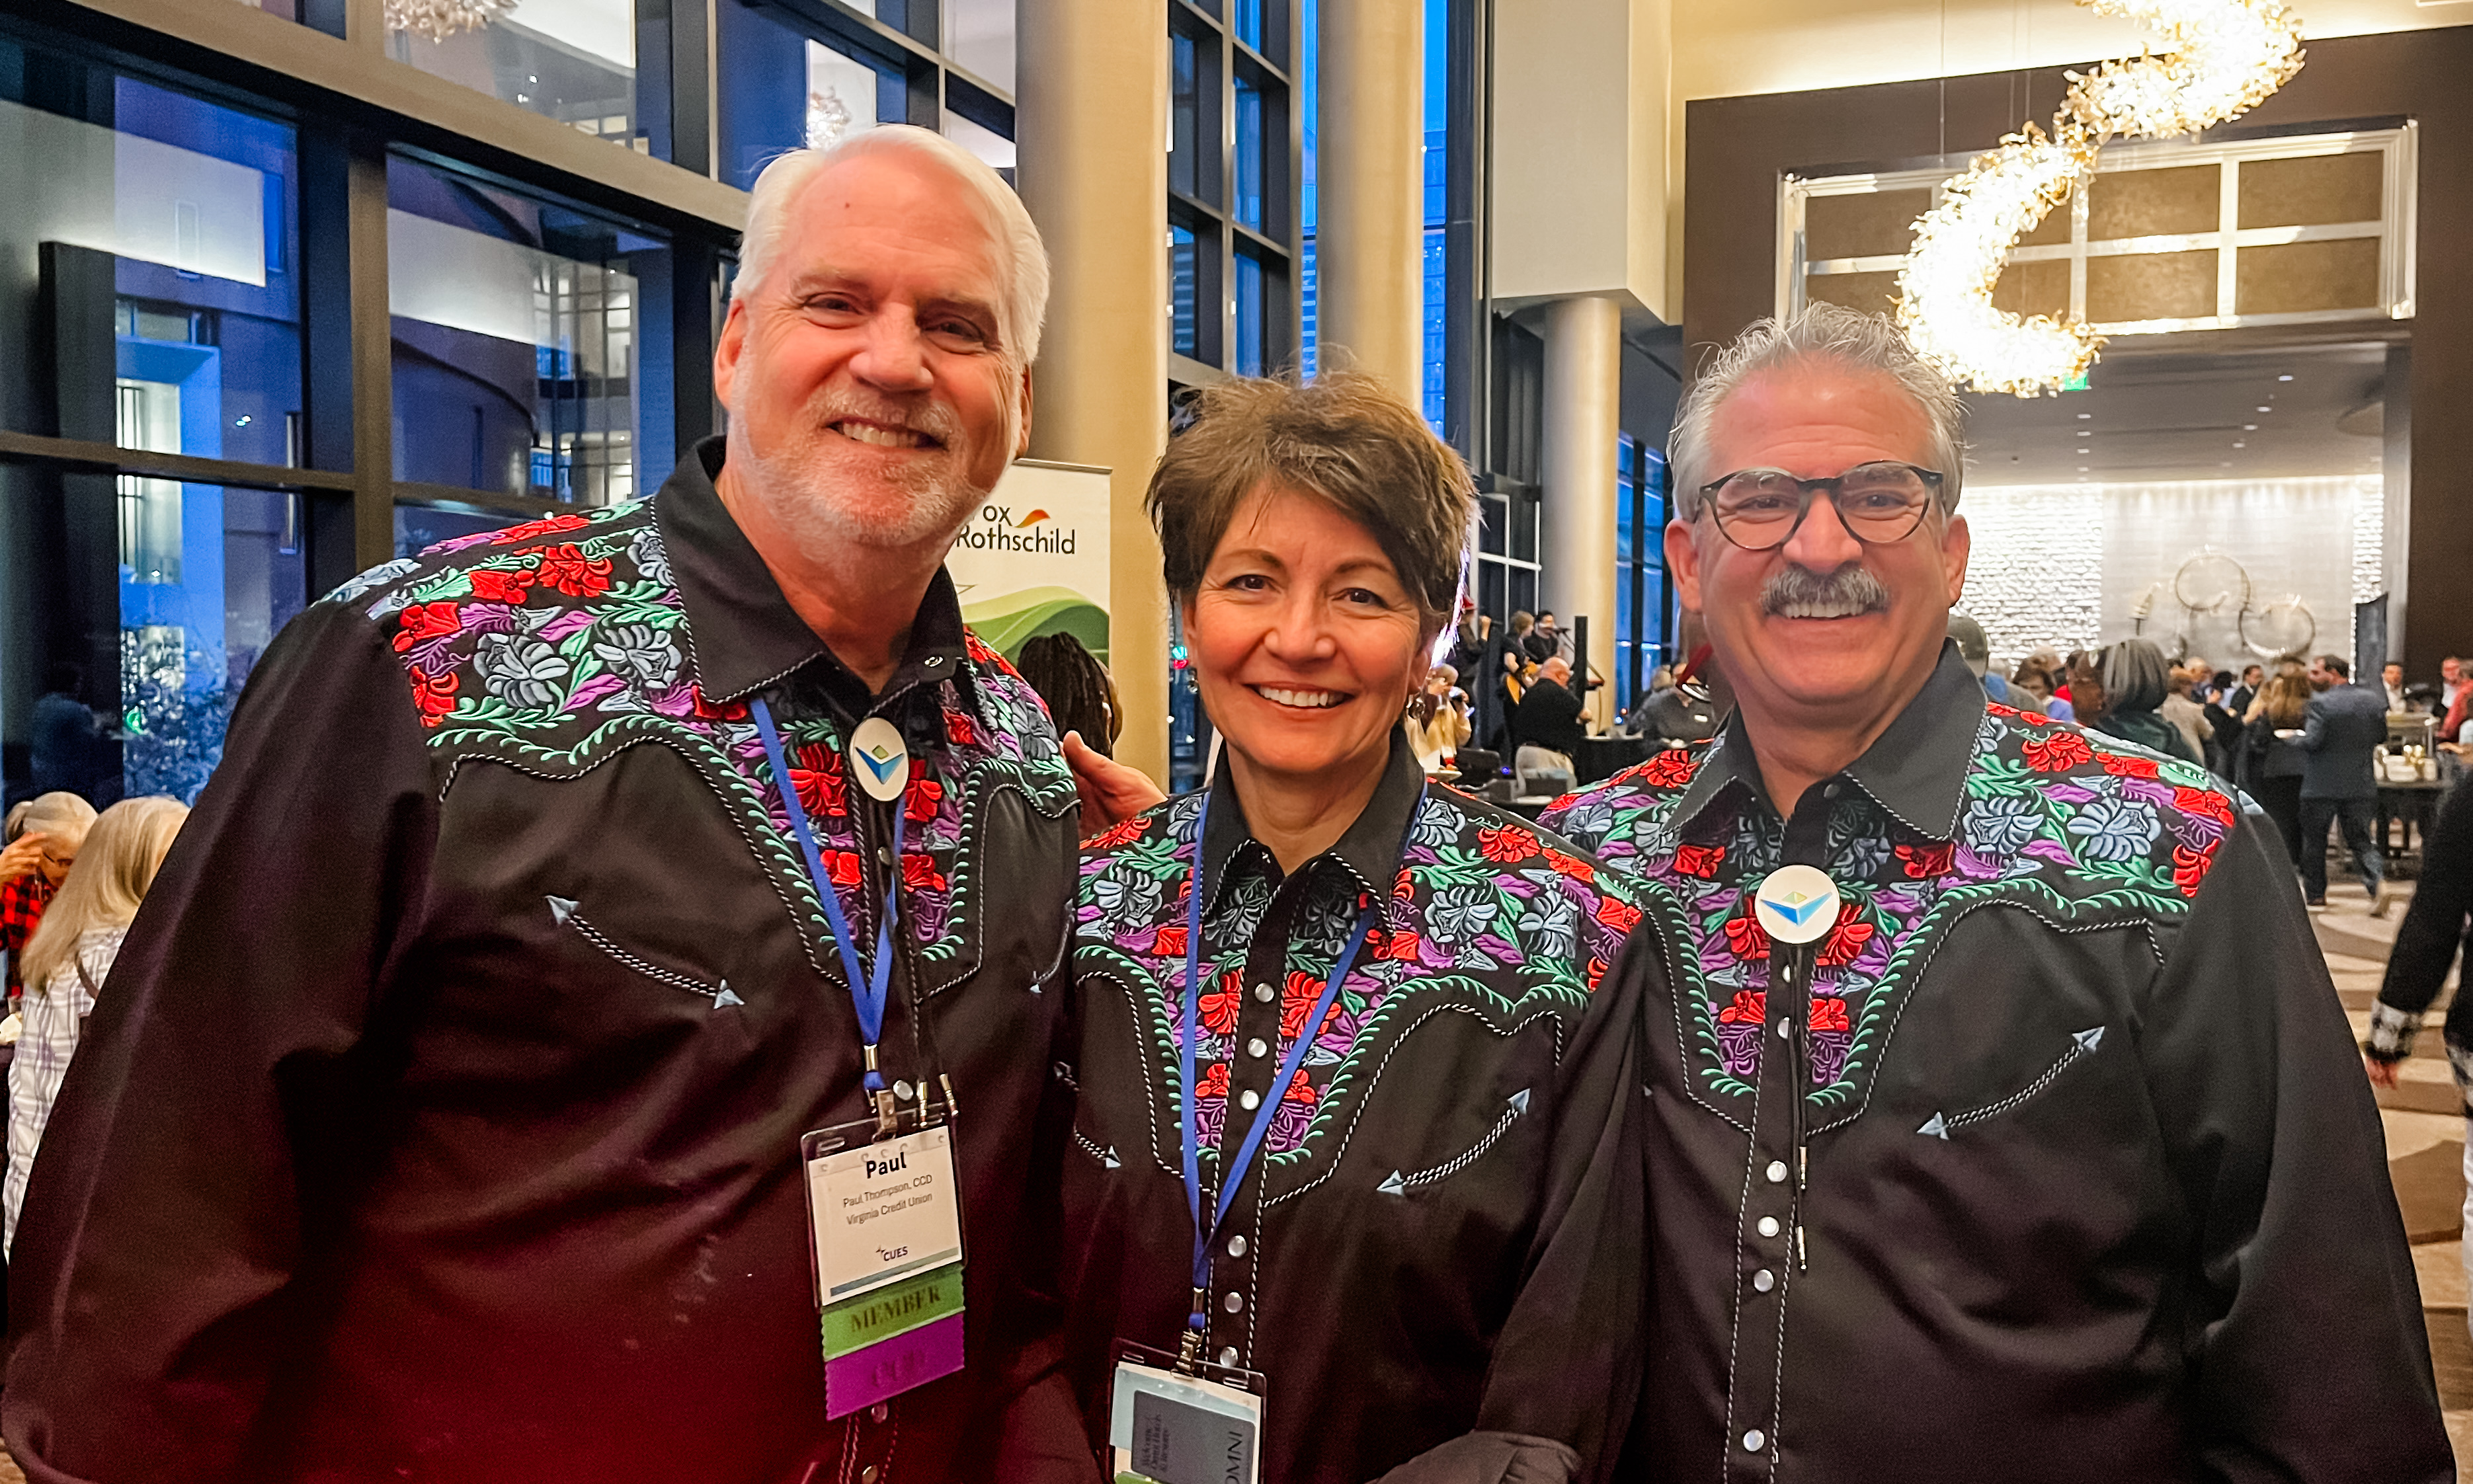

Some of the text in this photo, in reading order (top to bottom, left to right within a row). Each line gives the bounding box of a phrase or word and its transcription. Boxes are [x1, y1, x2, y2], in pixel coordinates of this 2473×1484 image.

[983, 505, 1013, 527] ox
[956, 523, 1075, 555] Rothschild
[866, 1152, 907, 1179] Paul
[843, 1194, 864, 1208] Paul
[913, 1174, 933, 1187] CCD
[881, 1200, 907, 1215] Credit
[908, 1193, 933, 1207] Union
[883, 1245, 909, 1261] CUES
[851, 1285, 941, 1333] MEMBER
